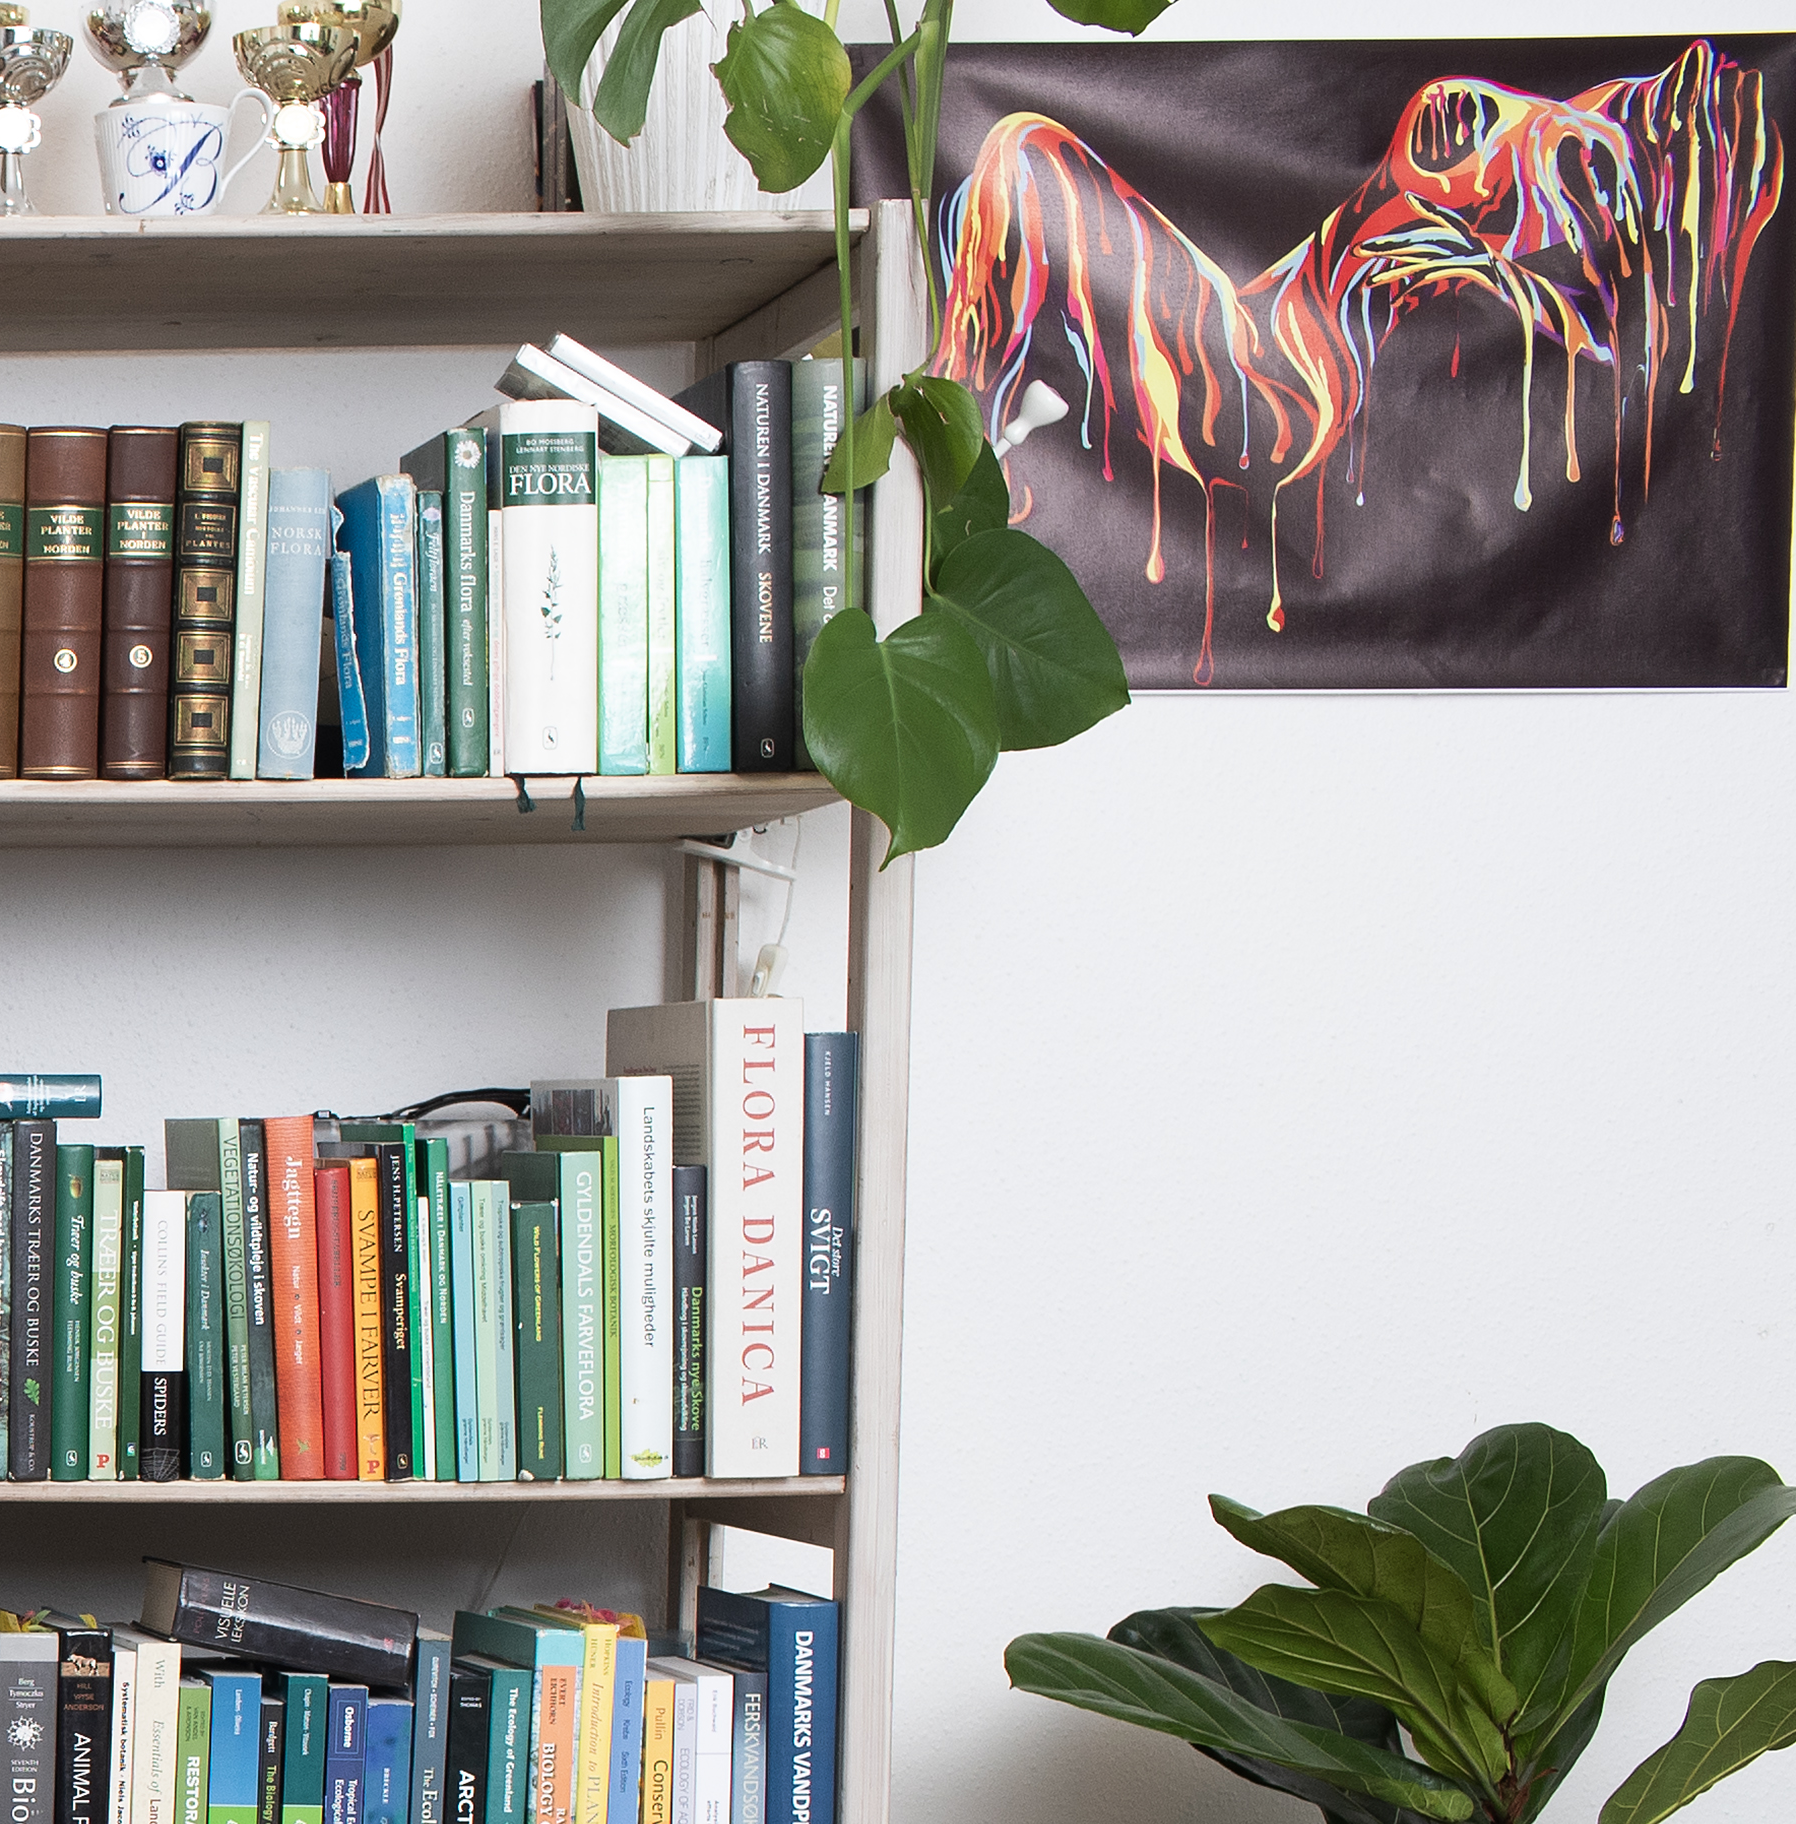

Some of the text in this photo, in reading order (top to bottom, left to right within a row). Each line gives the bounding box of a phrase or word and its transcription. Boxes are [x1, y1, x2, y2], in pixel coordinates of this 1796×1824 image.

[756, 383, 769, 455] NATUREN
[510, 473, 591, 496] FLORA
[757, 473, 771, 554] DANMARK
[270, 543, 322, 556] FLORA
[272, 528, 322, 539] NORSK
[460, 492, 475, 613] Danmarks flora
[759, 572, 772, 644] SKOVENE
[223, 1136, 245, 1321] VEGETATIONSØKOLOGI
[641, 1107, 656, 1348] Landskabets skjulte muligheder
[741, 1023, 776, 1407] FLORA DANICA
[810, 1209, 831, 1294] SVIGT
[358, 1210, 378, 1304] SVAMPE
[576, 1170, 595, 1421] GYLDENDALS FARVEFLORA
[393, 1273, 407, 1350] Svamperiget
[154, 1379, 167, 1436] SPIDERS
[362, 1331, 380, 1420] FARVER
[793, 1631, 813, 1748] DANMARKS
[71, 1732, 91, 1812] ANIMAL
